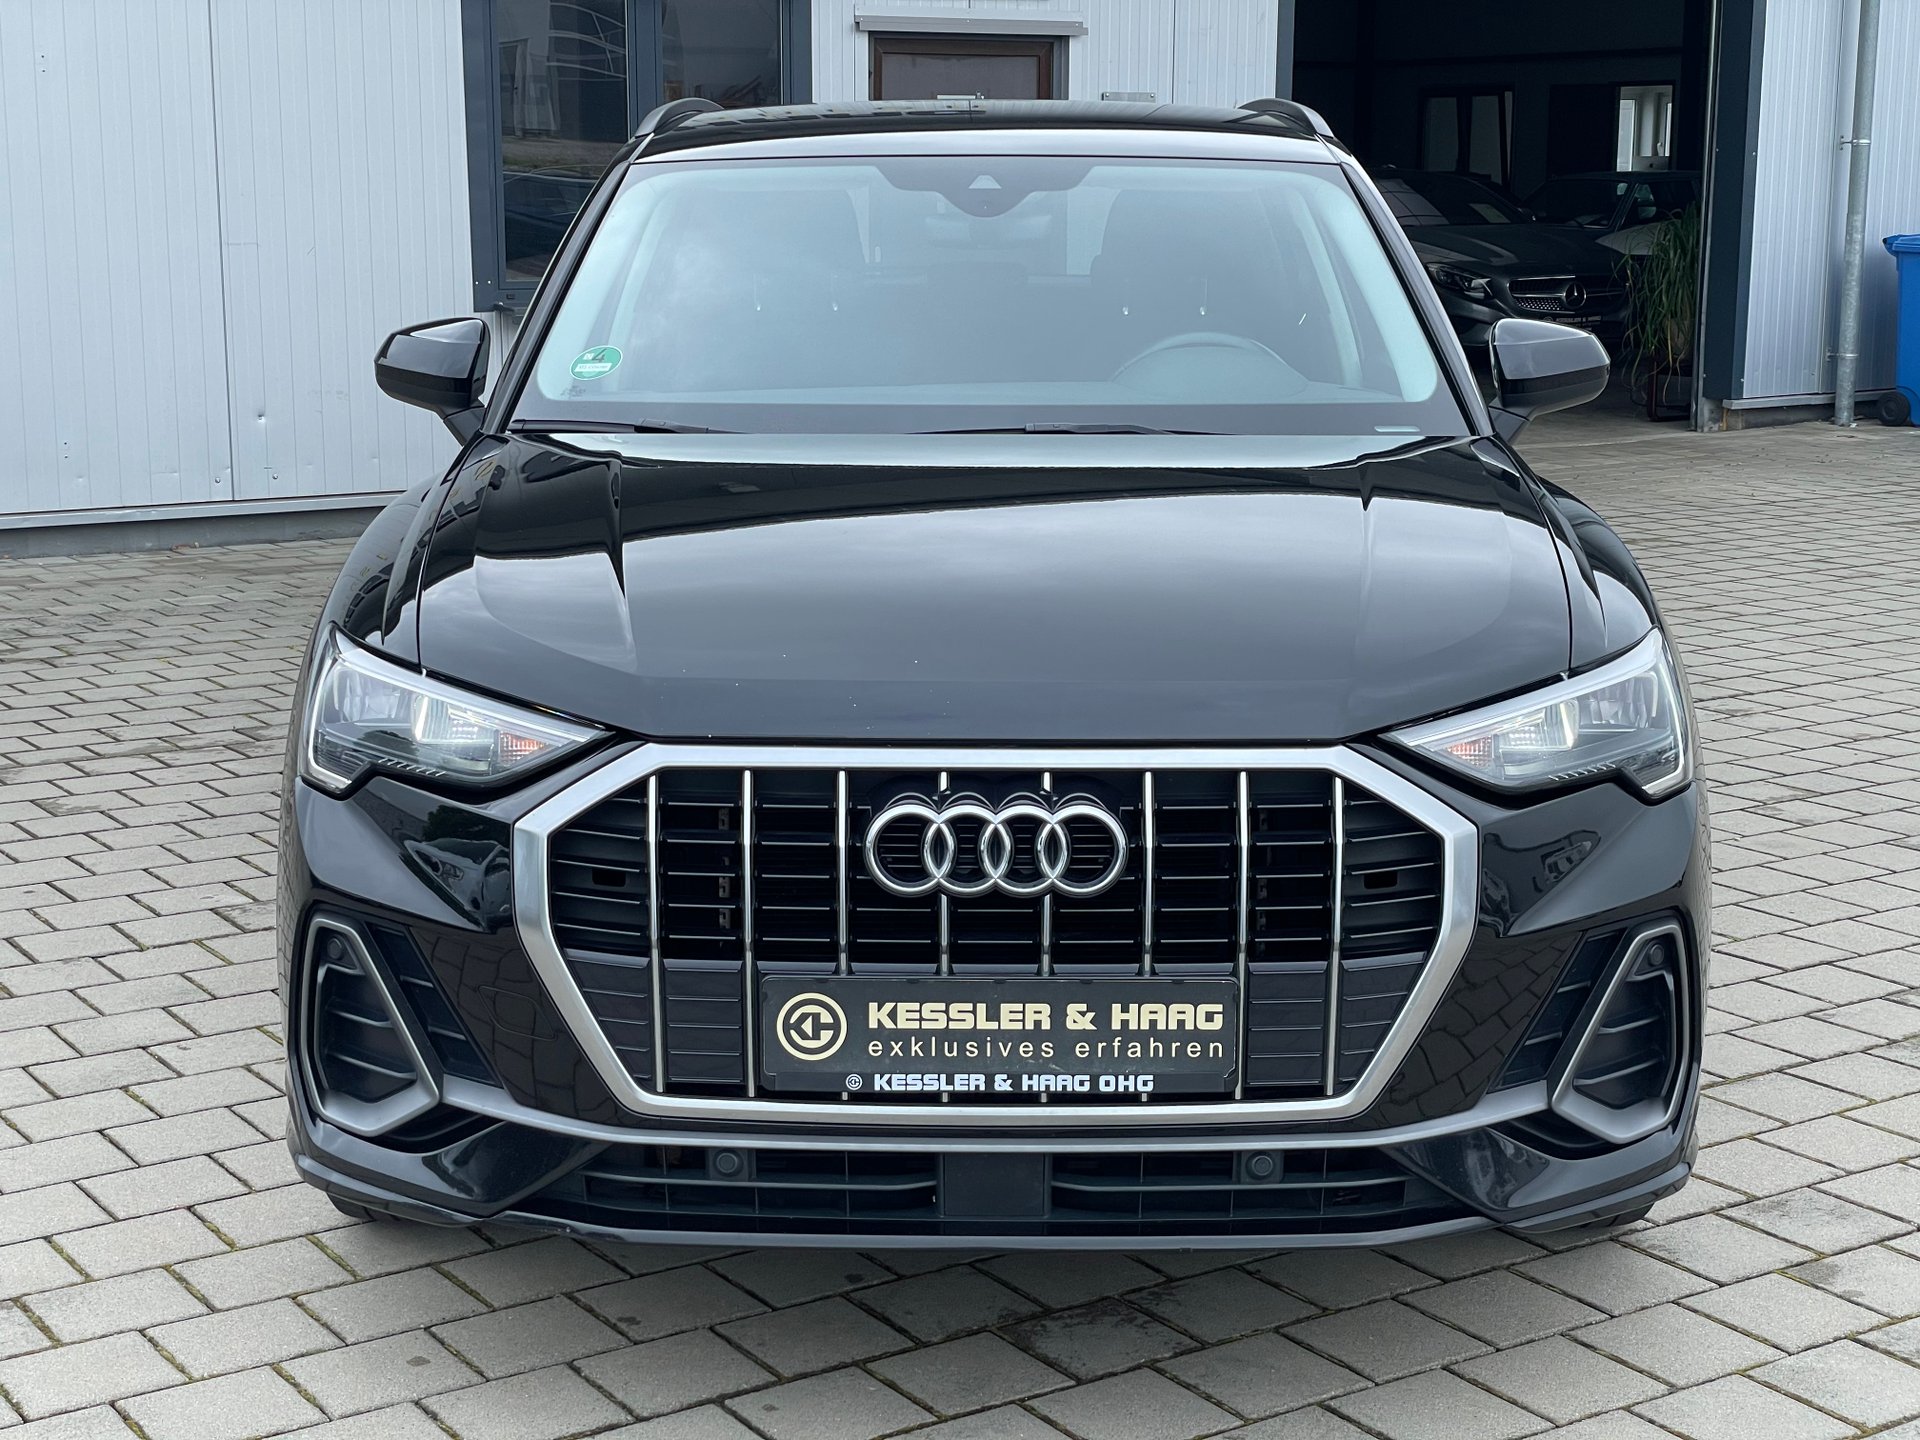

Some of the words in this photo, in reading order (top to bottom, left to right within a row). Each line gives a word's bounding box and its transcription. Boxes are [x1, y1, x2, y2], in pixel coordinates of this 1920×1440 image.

[592, 348, 606, 363] 4
[869, 1002, 1051, 1030] KESSLER
[1066, 1003, 1098, 1031] &
[1112, 1003, 1224, 1031] HAAG
[869, 1036, 1054, 1058] exklusives
[1075, 1037, 1224, 1058] erfahren
[874, 1073, 986, 1092] KESSLER
[994, 1074, 1014, 1092] &
[1022, 1074, 1091, 1093] HAAG
[1099, 1074, 1154, 1093] OHG
